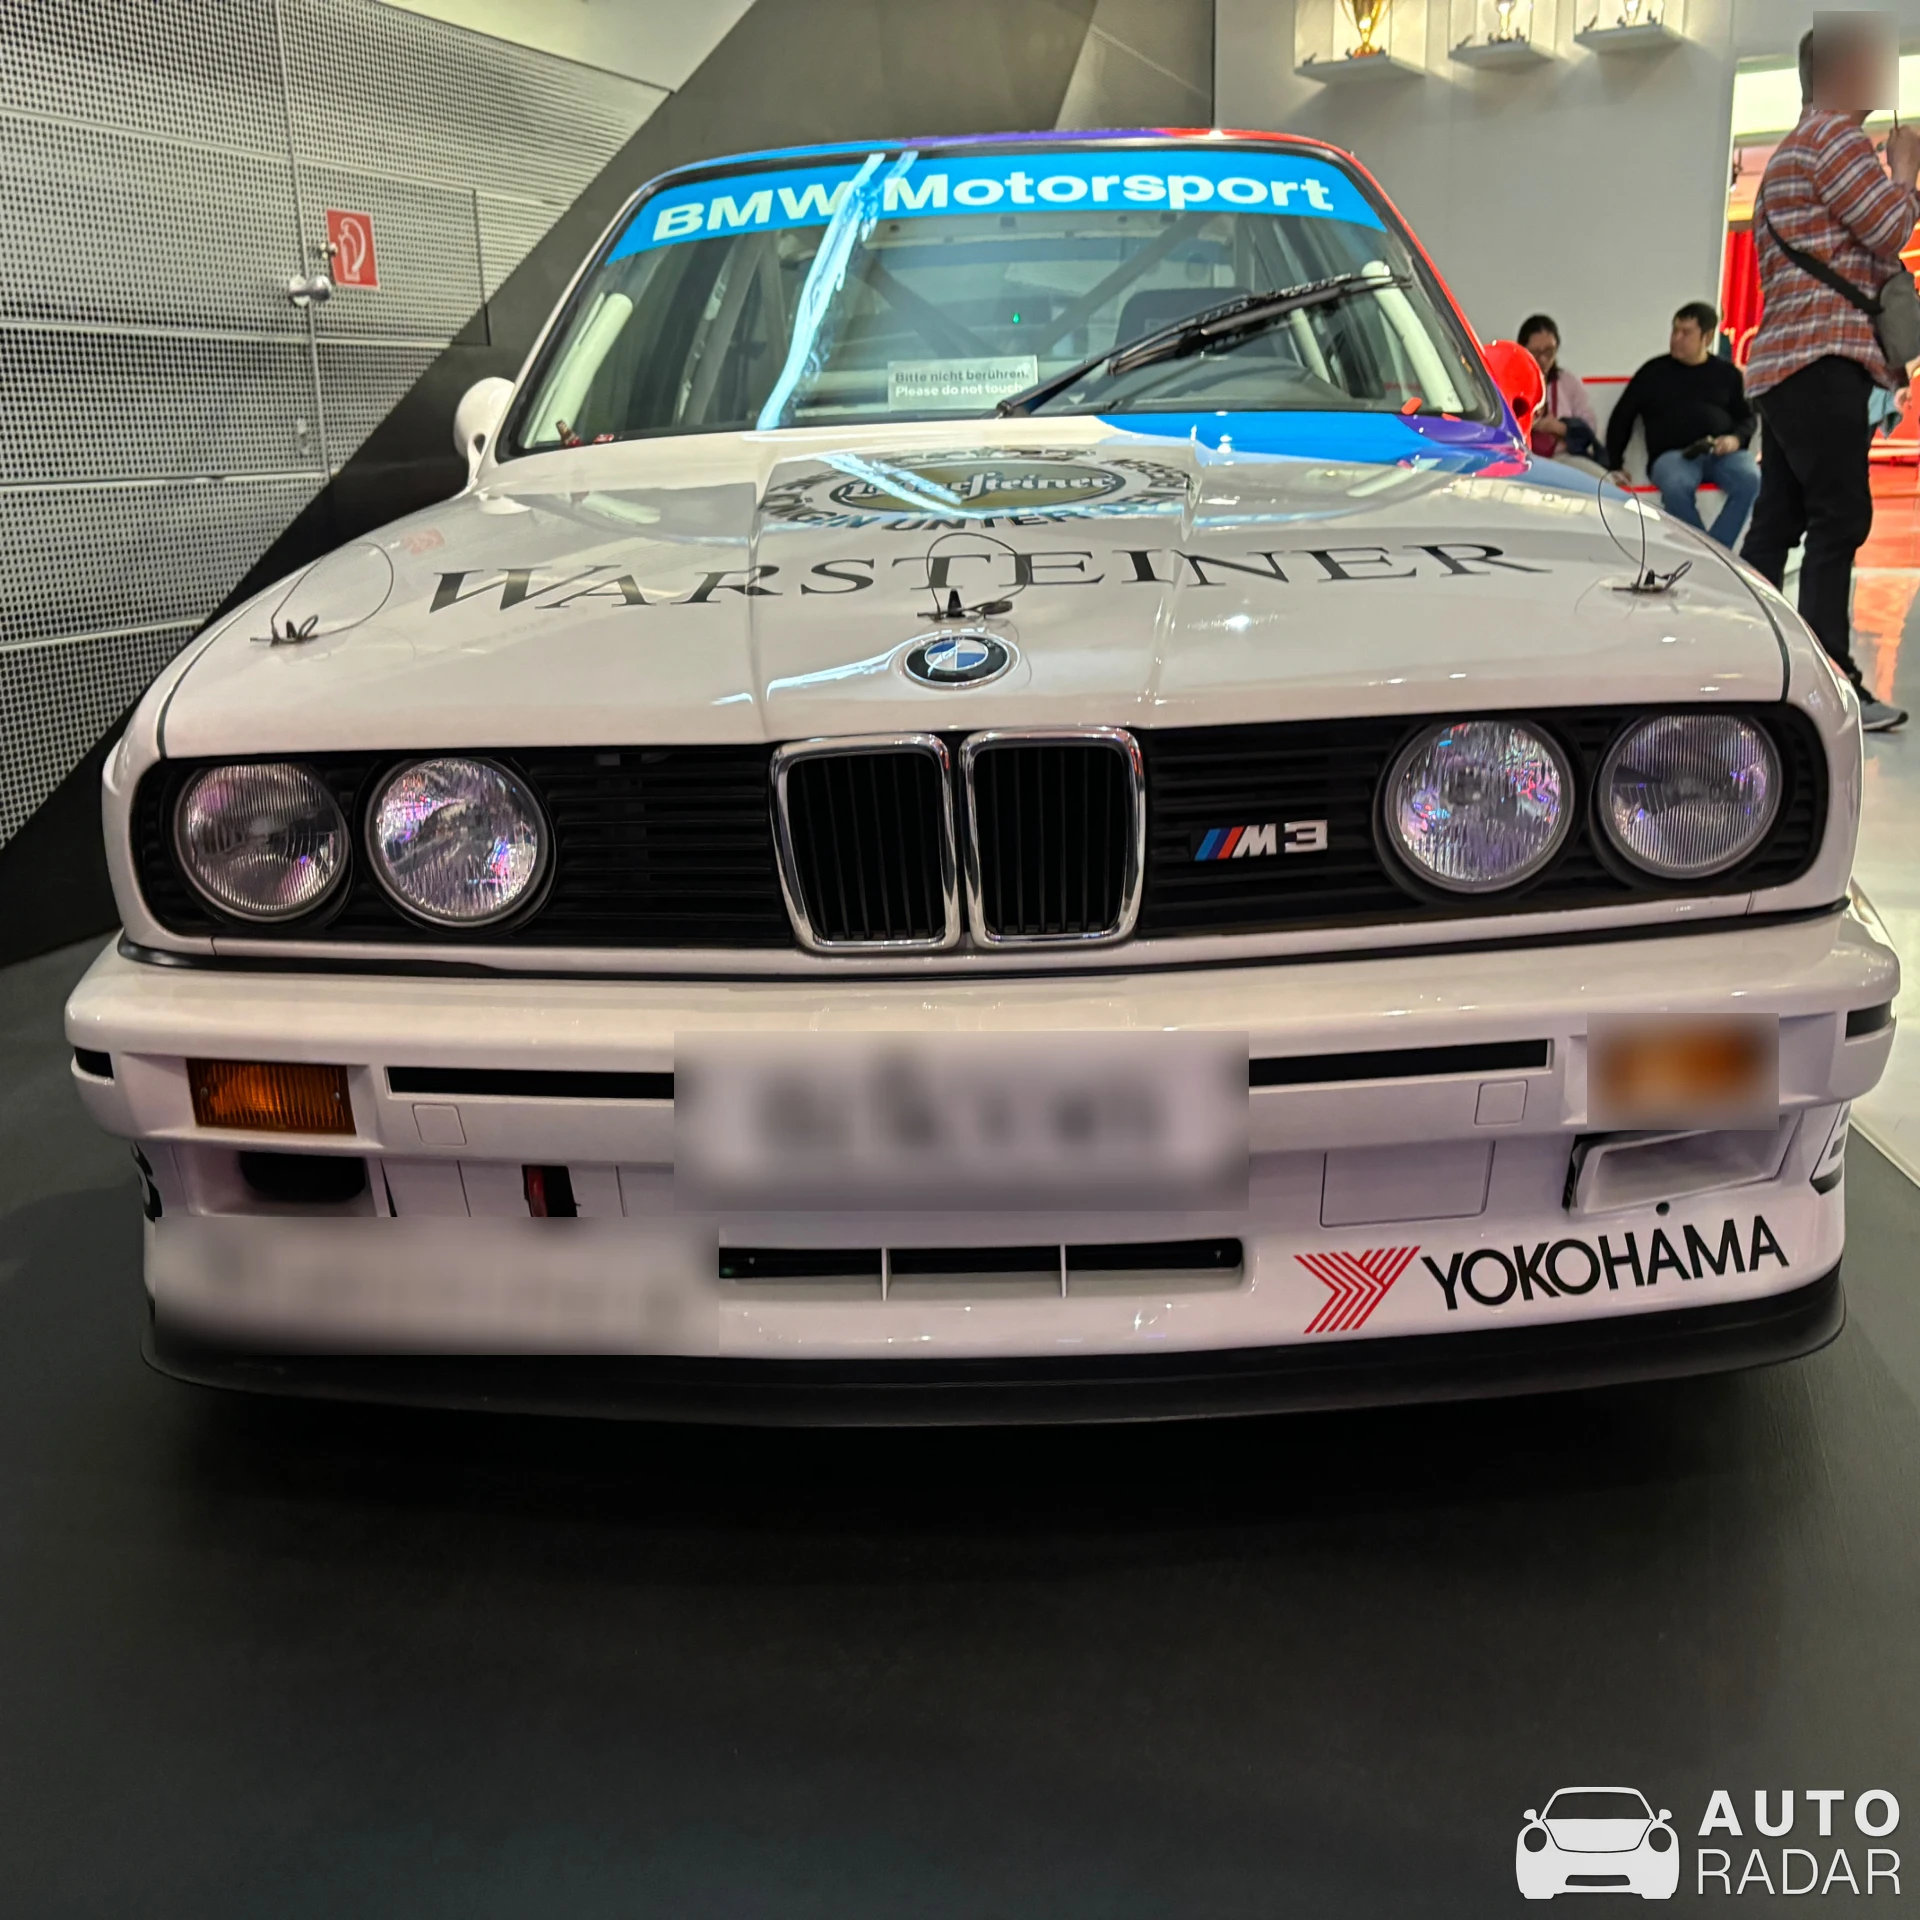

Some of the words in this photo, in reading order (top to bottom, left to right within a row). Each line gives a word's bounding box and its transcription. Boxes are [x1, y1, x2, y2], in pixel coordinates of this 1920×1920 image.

[652, 181, 852, 242] BMW
[883, 171, 1335, 212] Motorsport
[895, 372, 927, 384] Bitte
[930, 369, 964, 382] nicht
[895, 385, 939, 398] Please
[941, 384, 959, 395] do
[960, 383, 983, 395] not
[428, 543, 1553, 613] WARSTEINER
[1420, 1214, 1790, 1311] YOKOHAMA
